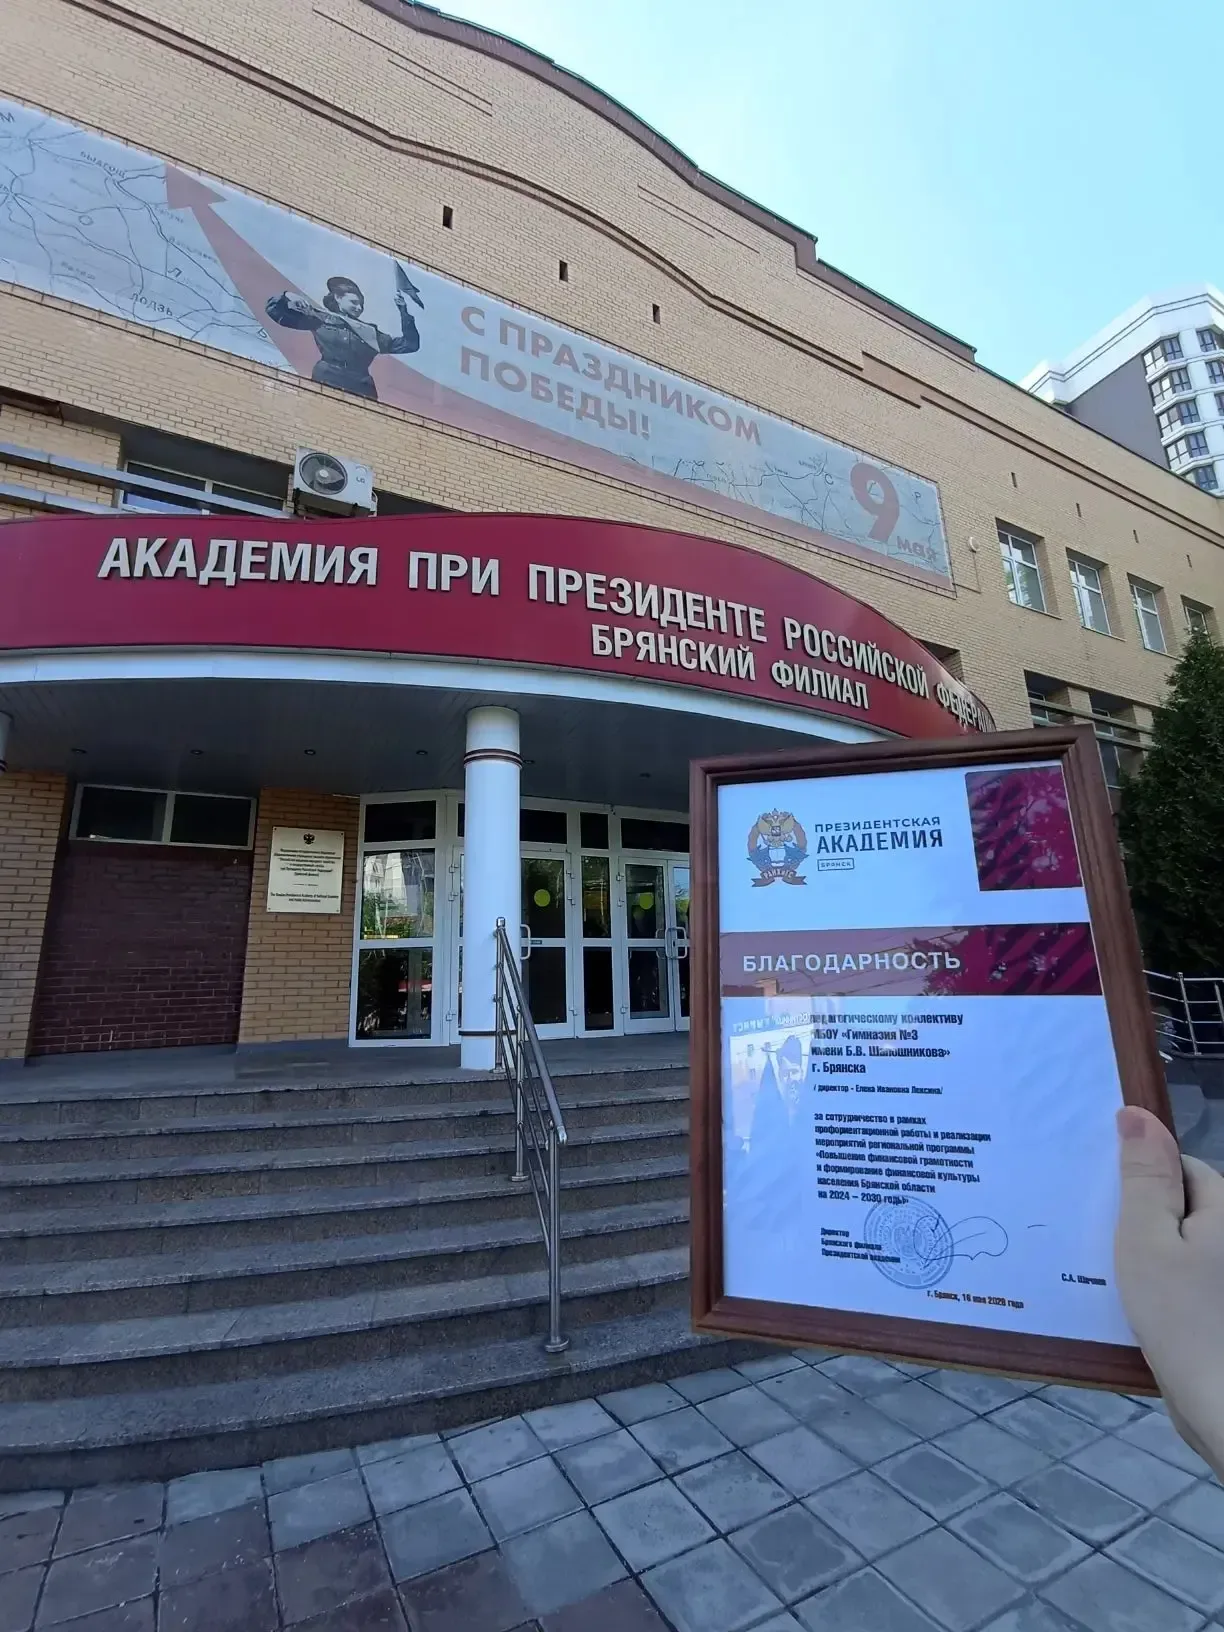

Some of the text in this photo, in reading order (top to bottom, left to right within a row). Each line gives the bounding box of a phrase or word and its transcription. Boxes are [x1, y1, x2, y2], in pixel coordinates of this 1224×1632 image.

[461, 306, 762, 446] С ПРАЗДНИКОМ
[460, 346, 650, 440] ПОБЕДЫ!
[850, 462, 900, 542] 9
[896, 535, 937, 561] мая
[98, 537, 378, 587] АКАДЕМИЯ
[409, 551, 499, 596] ПРИ
[529, 563, 767, 643] ПРЕЗИДЕНТЕ
[784, 617, 930, 700] РОССИЙСКОЙ
[591, 623, 870, 710] БРЯНСКИЙ ФИЛИАЛ
[815, 816, 941, 833] ПРЕЗИДЕНТСКАЯ
[816, 829, 944, 854] АКАДЕМИЯ
[820, 861, 852, 869] БРЯНСК
[743, 952, 961, 974] БЛАГОДАРНОСТЬ
[809, 1014, 963, 1026] педагогическому коллективу
[842, 1029, 897, 1040] «Гимназия
[900, 1029, 918, 1040] №3
[811, 1046, 843, 1056] имени
[846, 1046, 866, 1056] Б.В.
[812, 1062, 866, 1074] г. Брянска
[818, 1084, 849, 1093] директор
[855, 1084, 875, 1093] Елена
[877, 1085, 910, 1094] Ивановна
[814, 1113, 823, 1121] за
[825, 1112, 888, 1123] сотрудничество
[896, 1116, 927, 1126] рамках
[814, 1125, 992, 1143] профориентационной работы и реализации
[815, 1137, 975, 1155] мероприятий региональной программы
[815, 1150, 974, 1169] «Повышение финансовой грамотности
[816, 1164, 980, 1184] и формирование финансовой культуры
[817, 1176, 936, 1194] населения Брянской области
[817, 1190, 827, 1199] на
[829, 1190, 850, 1201] 2024
[860, 1192, 882, 1203] 2030
[1061, 1273, 1076, 1283] С.А.
